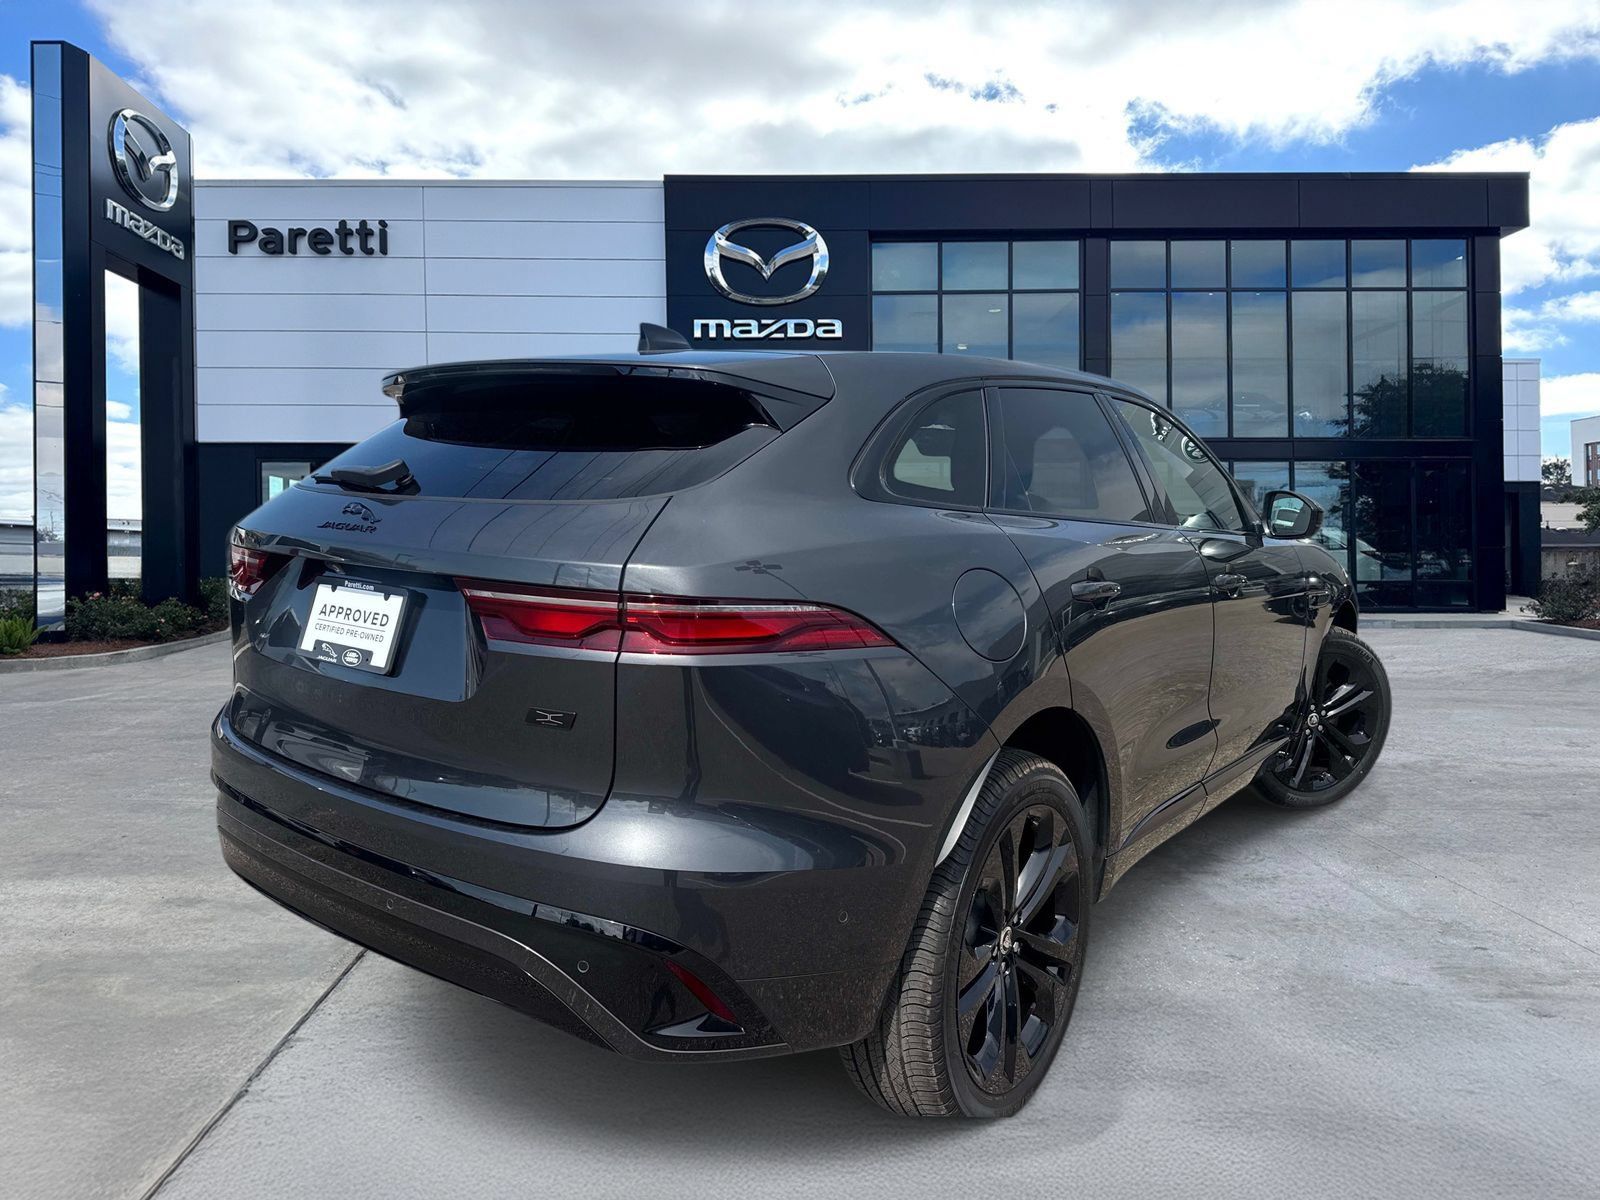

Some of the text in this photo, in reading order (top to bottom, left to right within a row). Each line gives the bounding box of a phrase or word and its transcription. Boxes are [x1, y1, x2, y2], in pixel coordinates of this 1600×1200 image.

[227, 219, 389, 256] Paretti
[316, 520, 377, 533] JAGUAR
[344, 580, 375, 591] Paretti.com
[318, 603, 390, 627] APPROVED
[314, 622, 385, 643] CERTIFIED PRE-OWNED
